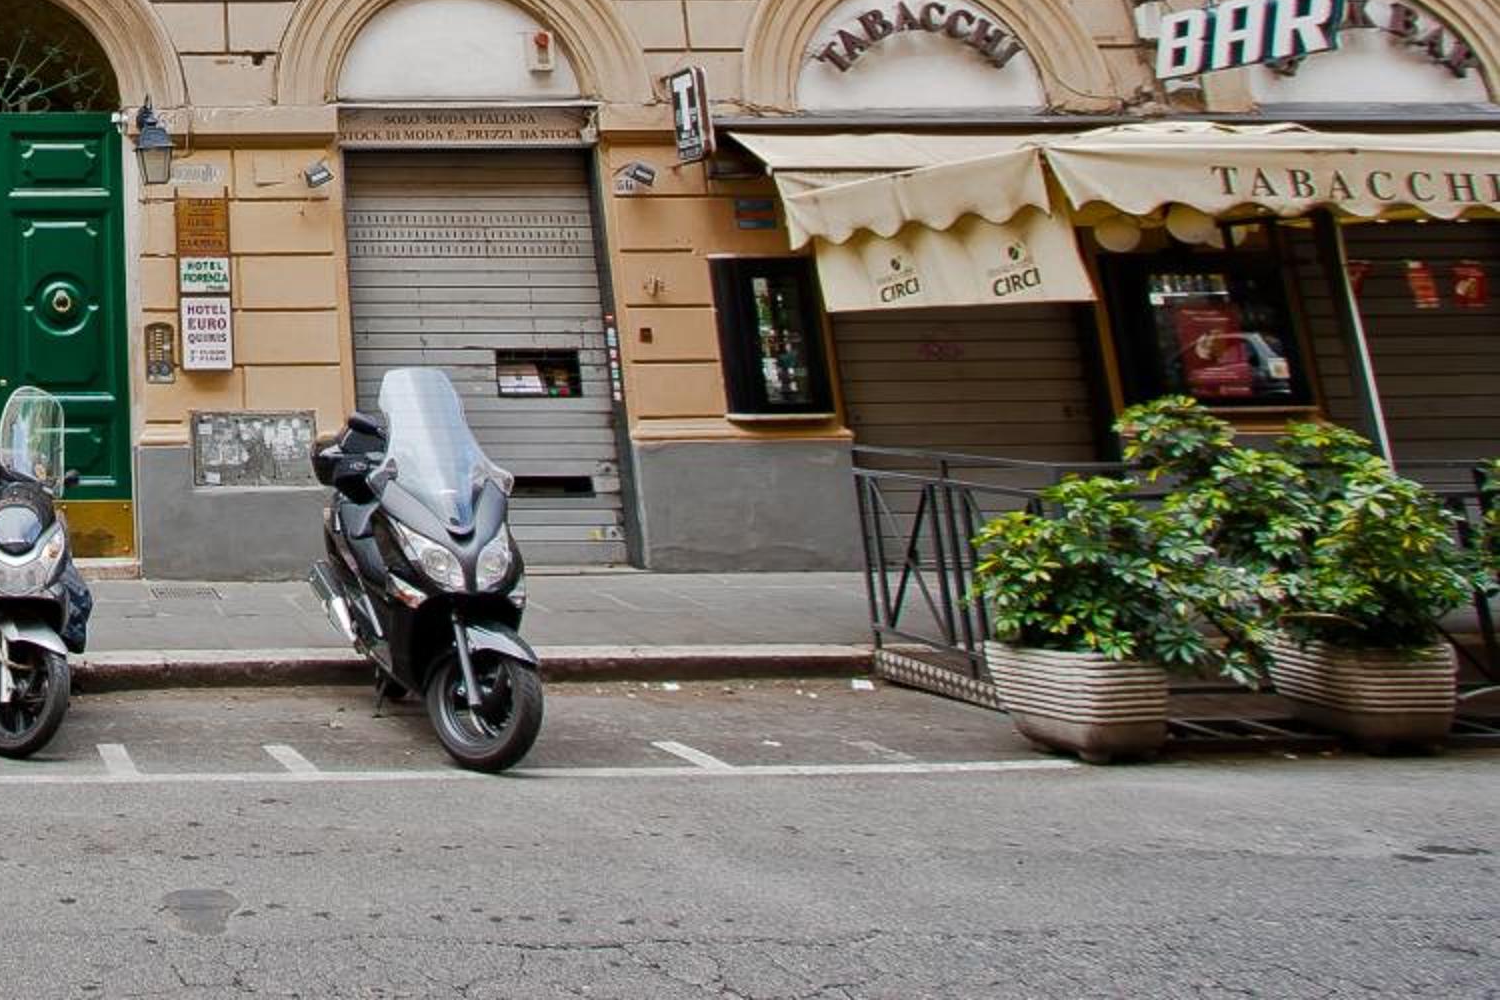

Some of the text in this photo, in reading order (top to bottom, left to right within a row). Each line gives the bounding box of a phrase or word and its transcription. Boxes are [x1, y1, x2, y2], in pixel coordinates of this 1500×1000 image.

[811, 0, 1027, 72] TABACCHI
[404, 129, 443, 140] MODA
[1211, 165, 1500, 204] TABACCHI
[186, 261, 223, 271] HOTEL
[880, 277, 921, 303] CIRCI
[993, 267, 1042, 297] CIRCI
[187, 304, 227, 316] HOTEL
[187, 318, 228, 331] EURO
